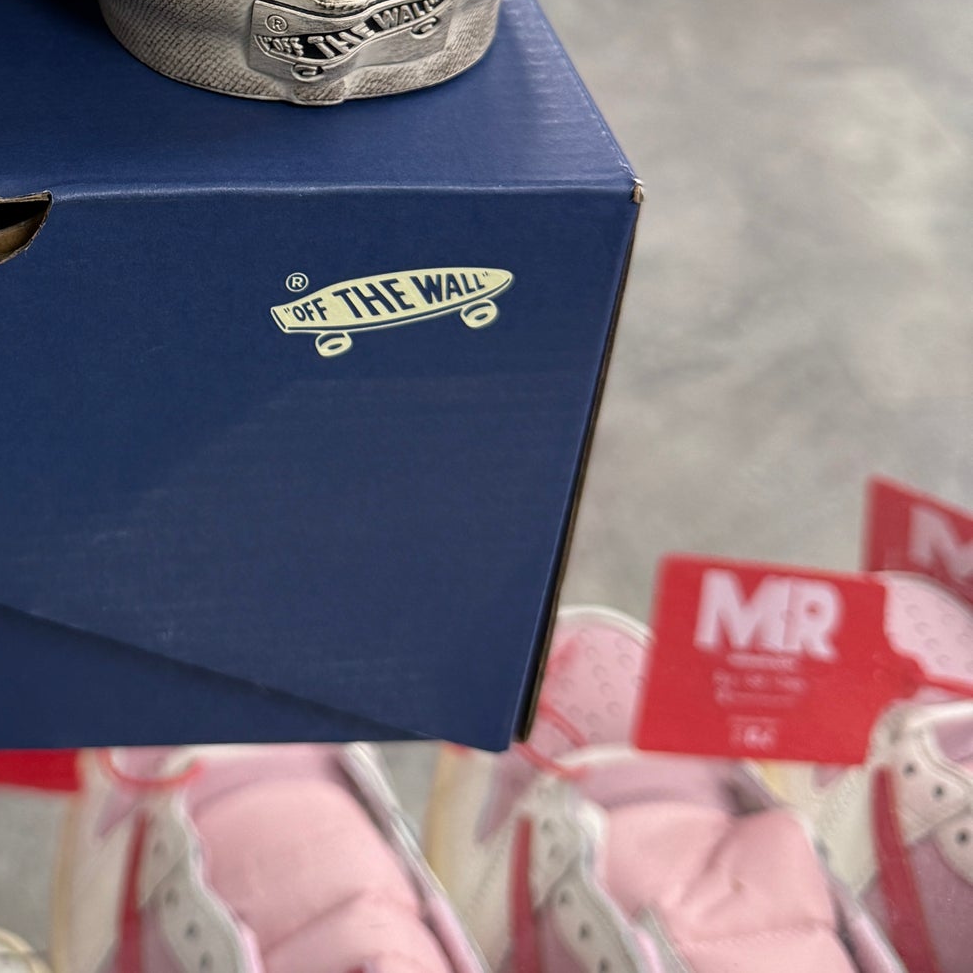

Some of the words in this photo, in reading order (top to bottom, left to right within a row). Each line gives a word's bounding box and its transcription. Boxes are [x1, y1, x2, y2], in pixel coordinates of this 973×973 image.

[307, 21, 376, 59] THE
[331, 278, 416, 319] THE
[692, 567, 842, 663] MR
